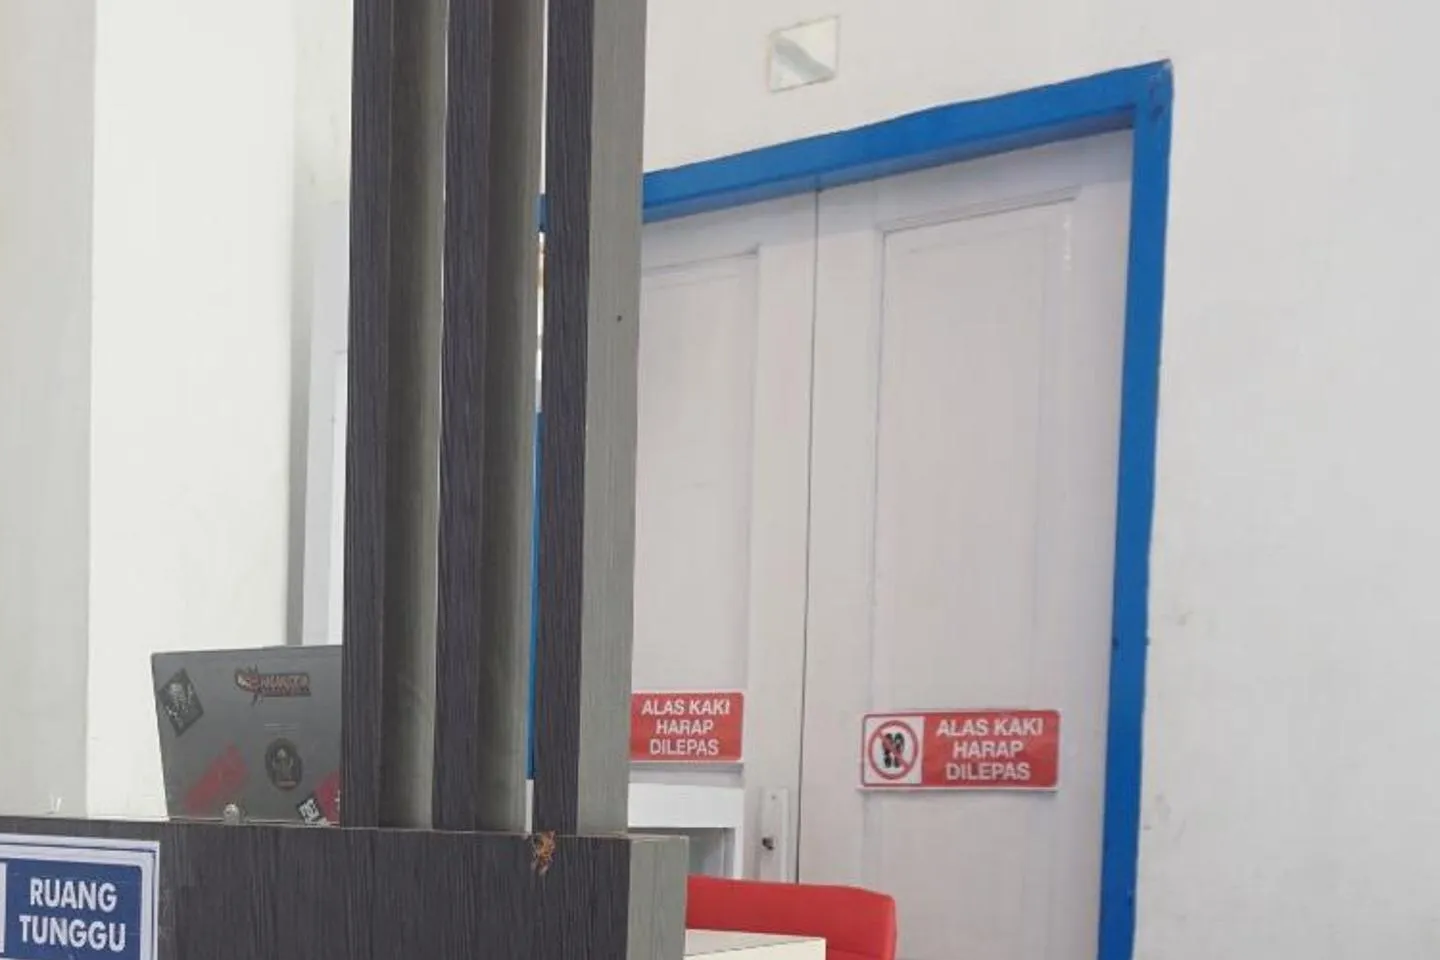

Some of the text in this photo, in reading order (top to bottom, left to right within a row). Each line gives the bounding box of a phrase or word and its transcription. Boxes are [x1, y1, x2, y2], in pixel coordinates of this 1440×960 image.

[641, 698, 730, 715] ALAS KAKI
[655, 718, 714, 735] HARAP
[936, 717, 1044, 737] ALAS KAKI
[649, 738, 720, 756] DILEPAS
[952, 740, 1024, 759] HARAP
[945, 762, 1031, 781] DILEPAS
[29, 876, 118, 913] RUANG
[19, 914, 126, 952] TUNGGU
